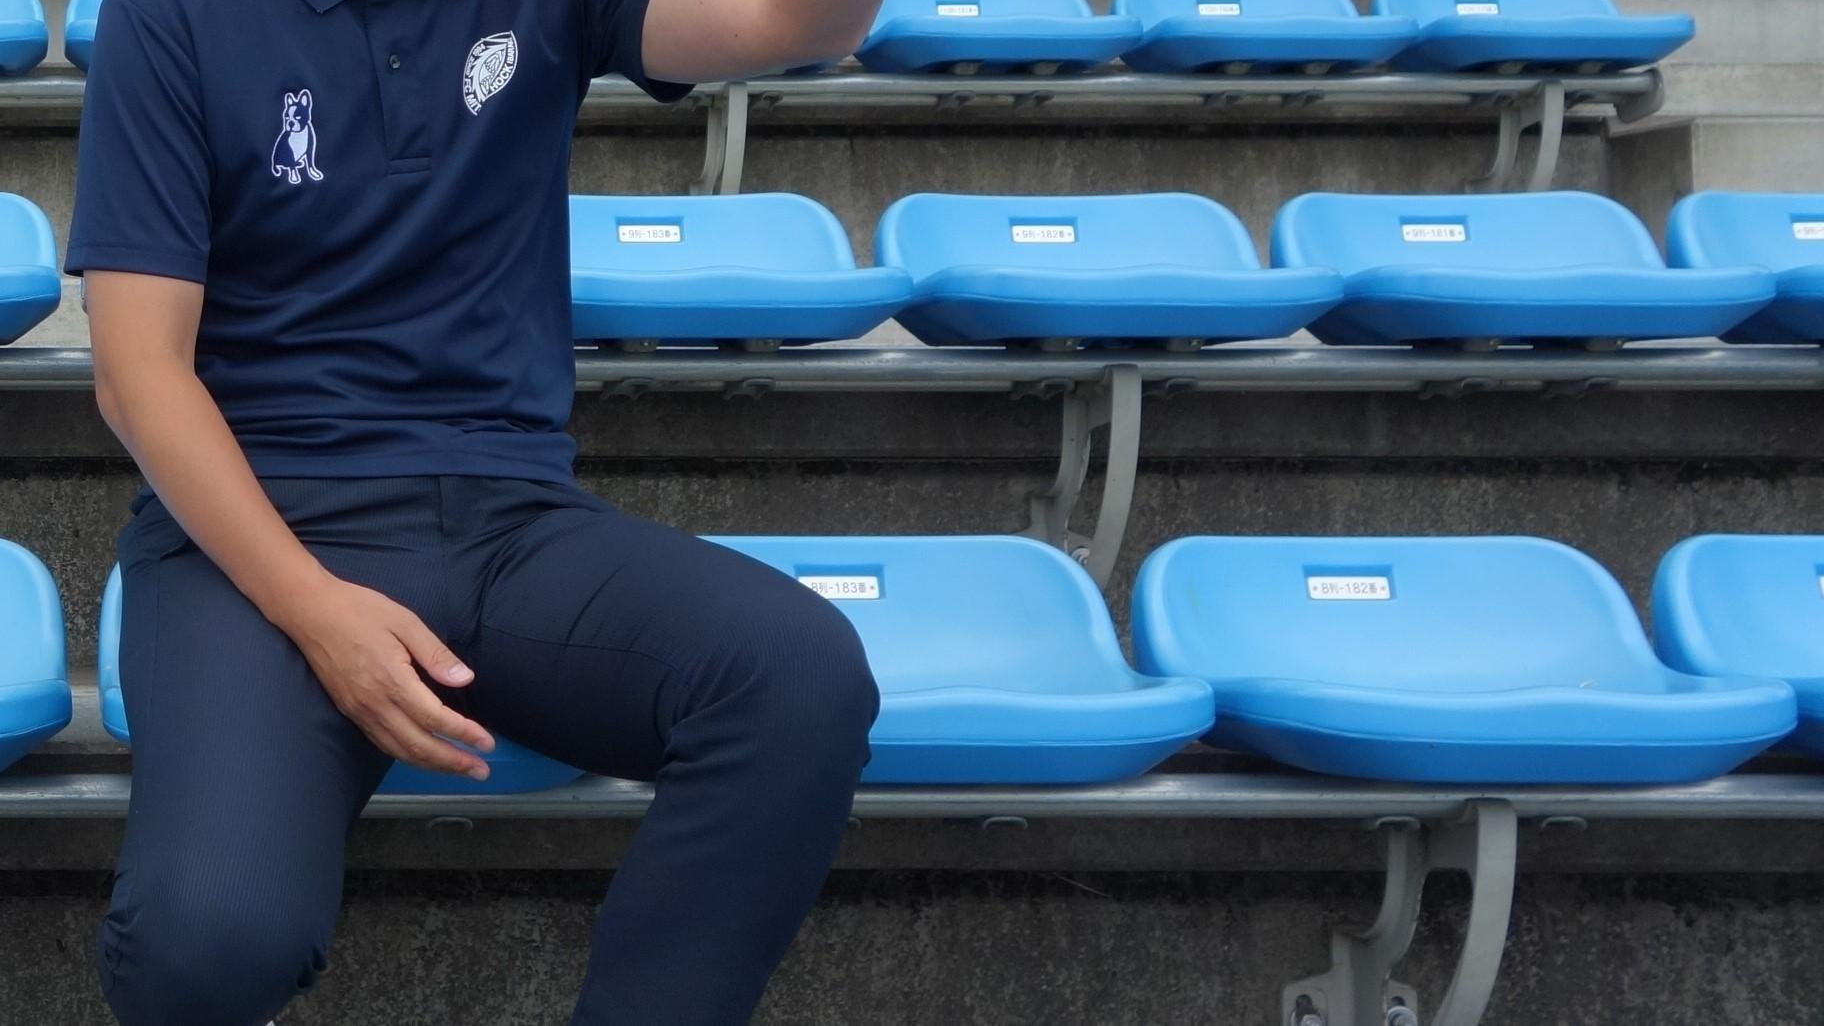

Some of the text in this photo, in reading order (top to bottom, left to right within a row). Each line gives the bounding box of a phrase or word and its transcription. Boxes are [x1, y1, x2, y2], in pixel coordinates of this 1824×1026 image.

[466, 93, 482, 112] MIT
[811, 581, 867, 594] 8列-183番
[1321, 582, 1378, 595] 8列-182番
